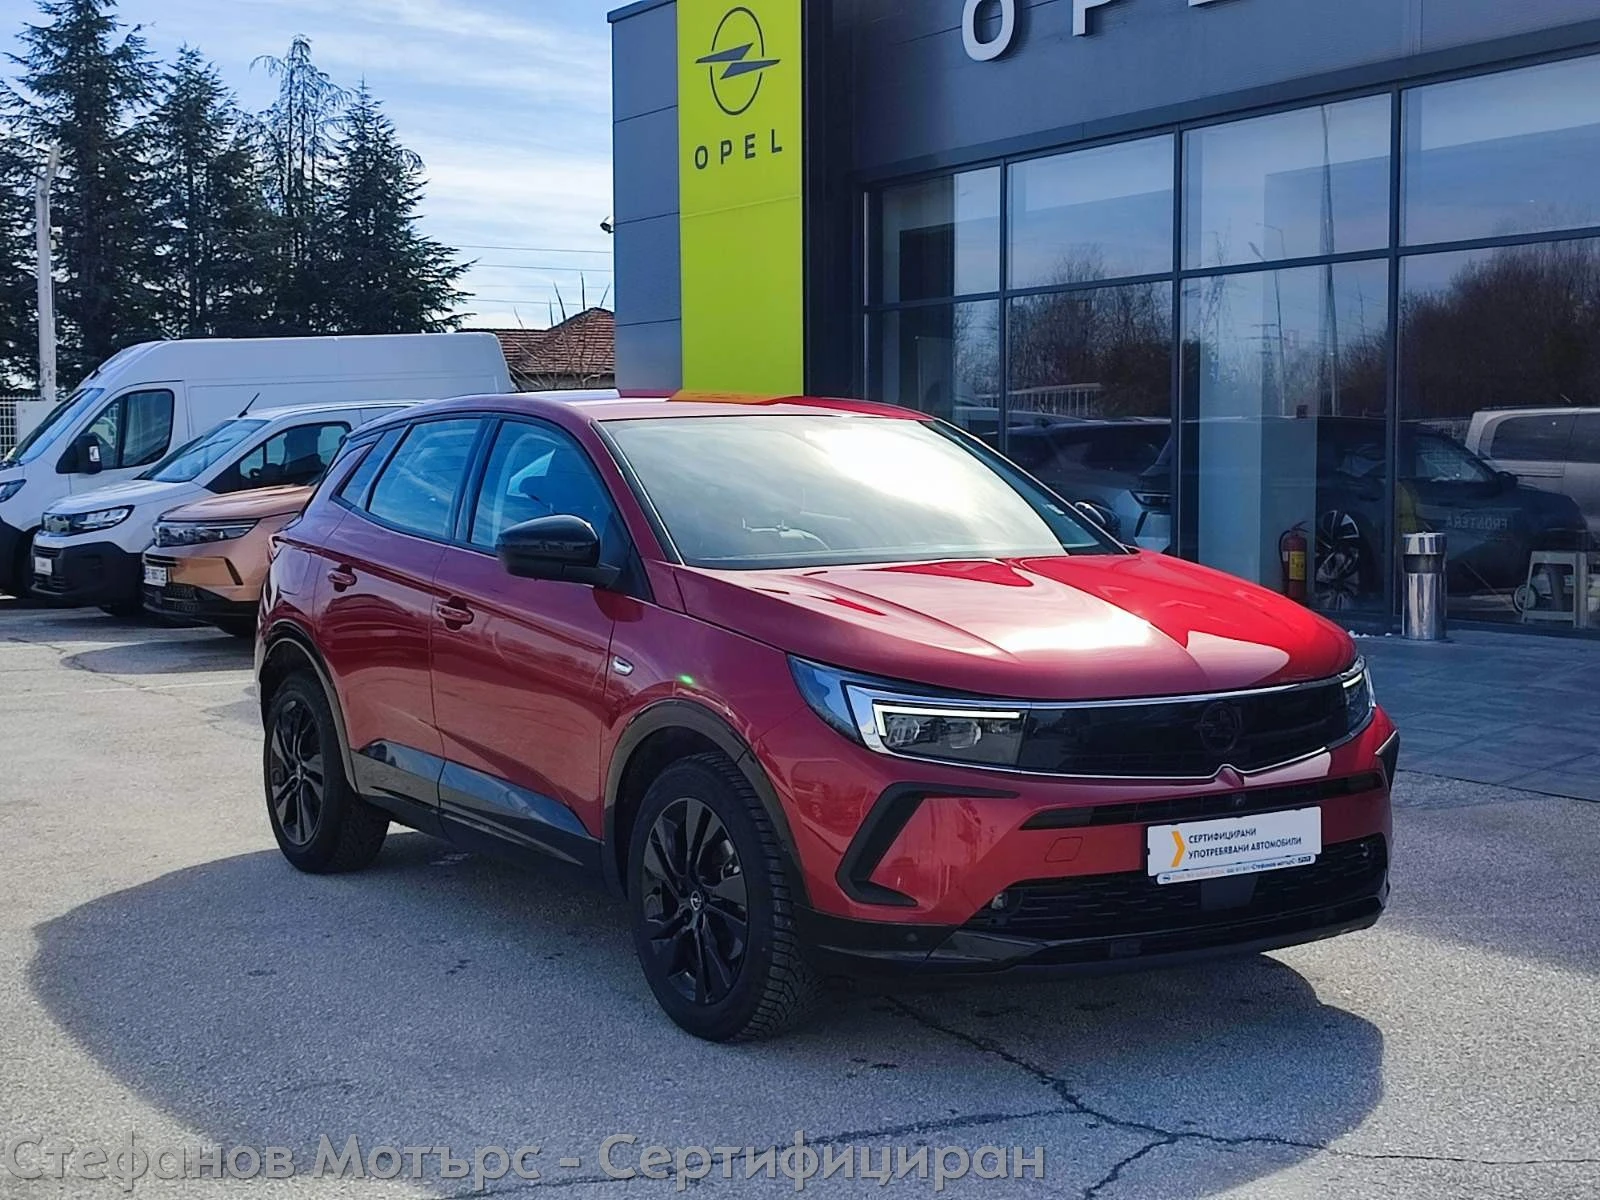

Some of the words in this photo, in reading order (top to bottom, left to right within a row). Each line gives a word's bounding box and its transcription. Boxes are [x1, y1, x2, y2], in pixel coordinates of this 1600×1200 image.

[694, 128, 783, 170] OPEL
[1188, 827, 1257, 844] СЕРТИФИЦИРАНИ
[1188, 843, 1250, 860] УПОТРЕБЯВАНИ
[1250, 836, 1302, 851] АВТОМОБИЛИ
